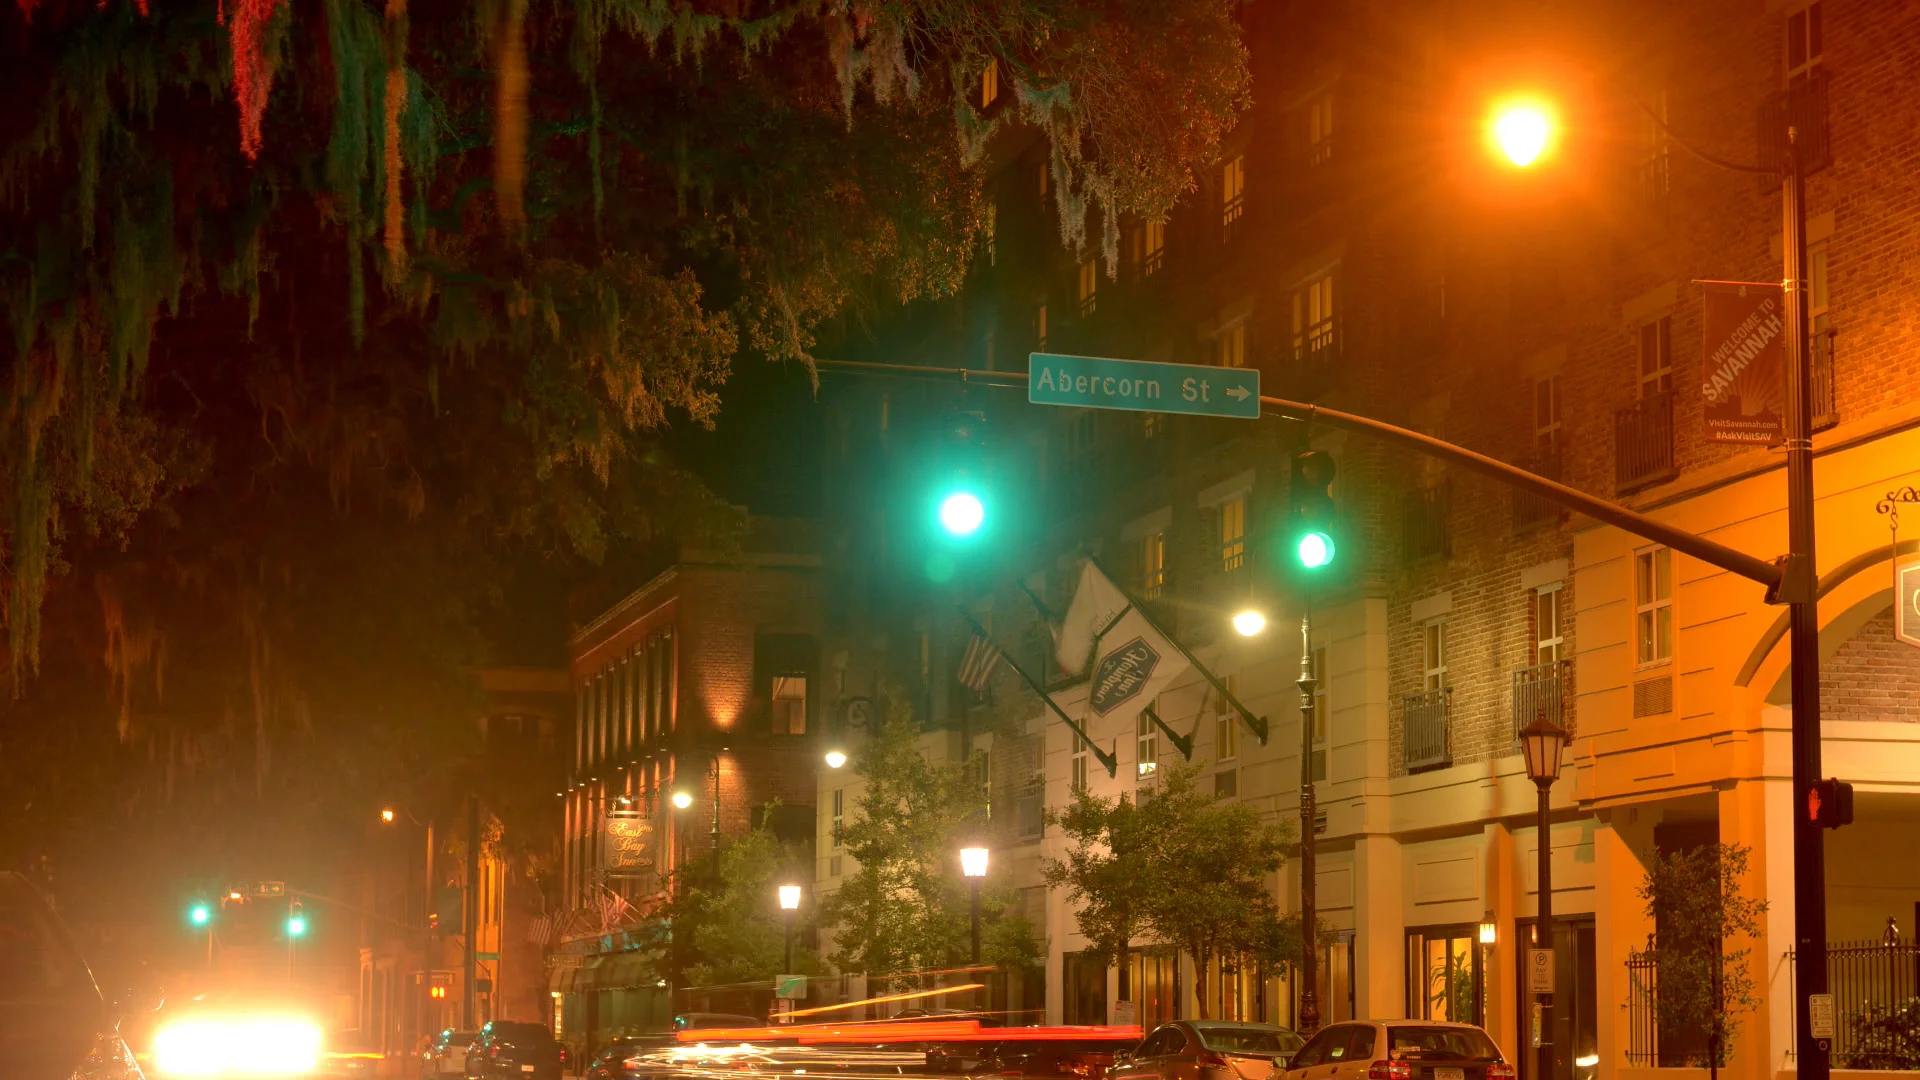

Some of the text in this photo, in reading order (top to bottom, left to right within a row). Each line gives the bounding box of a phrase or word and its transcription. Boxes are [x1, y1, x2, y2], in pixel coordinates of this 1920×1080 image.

[1711, 298, 1775, 364] WELCOME TO
[1702, 313, 1783, 401] SAVANNAH
[1036, 366, 1210, 403] Abercorn St
[1708, 419, 1778, 429] VisitSavannah.com
[1716, 431, 1772, 441] #AskVisitSAV
[608, 822, 653, 838] East
[612, 837, 645, 856] Bay
[609, 851, 653, 869] Inn
